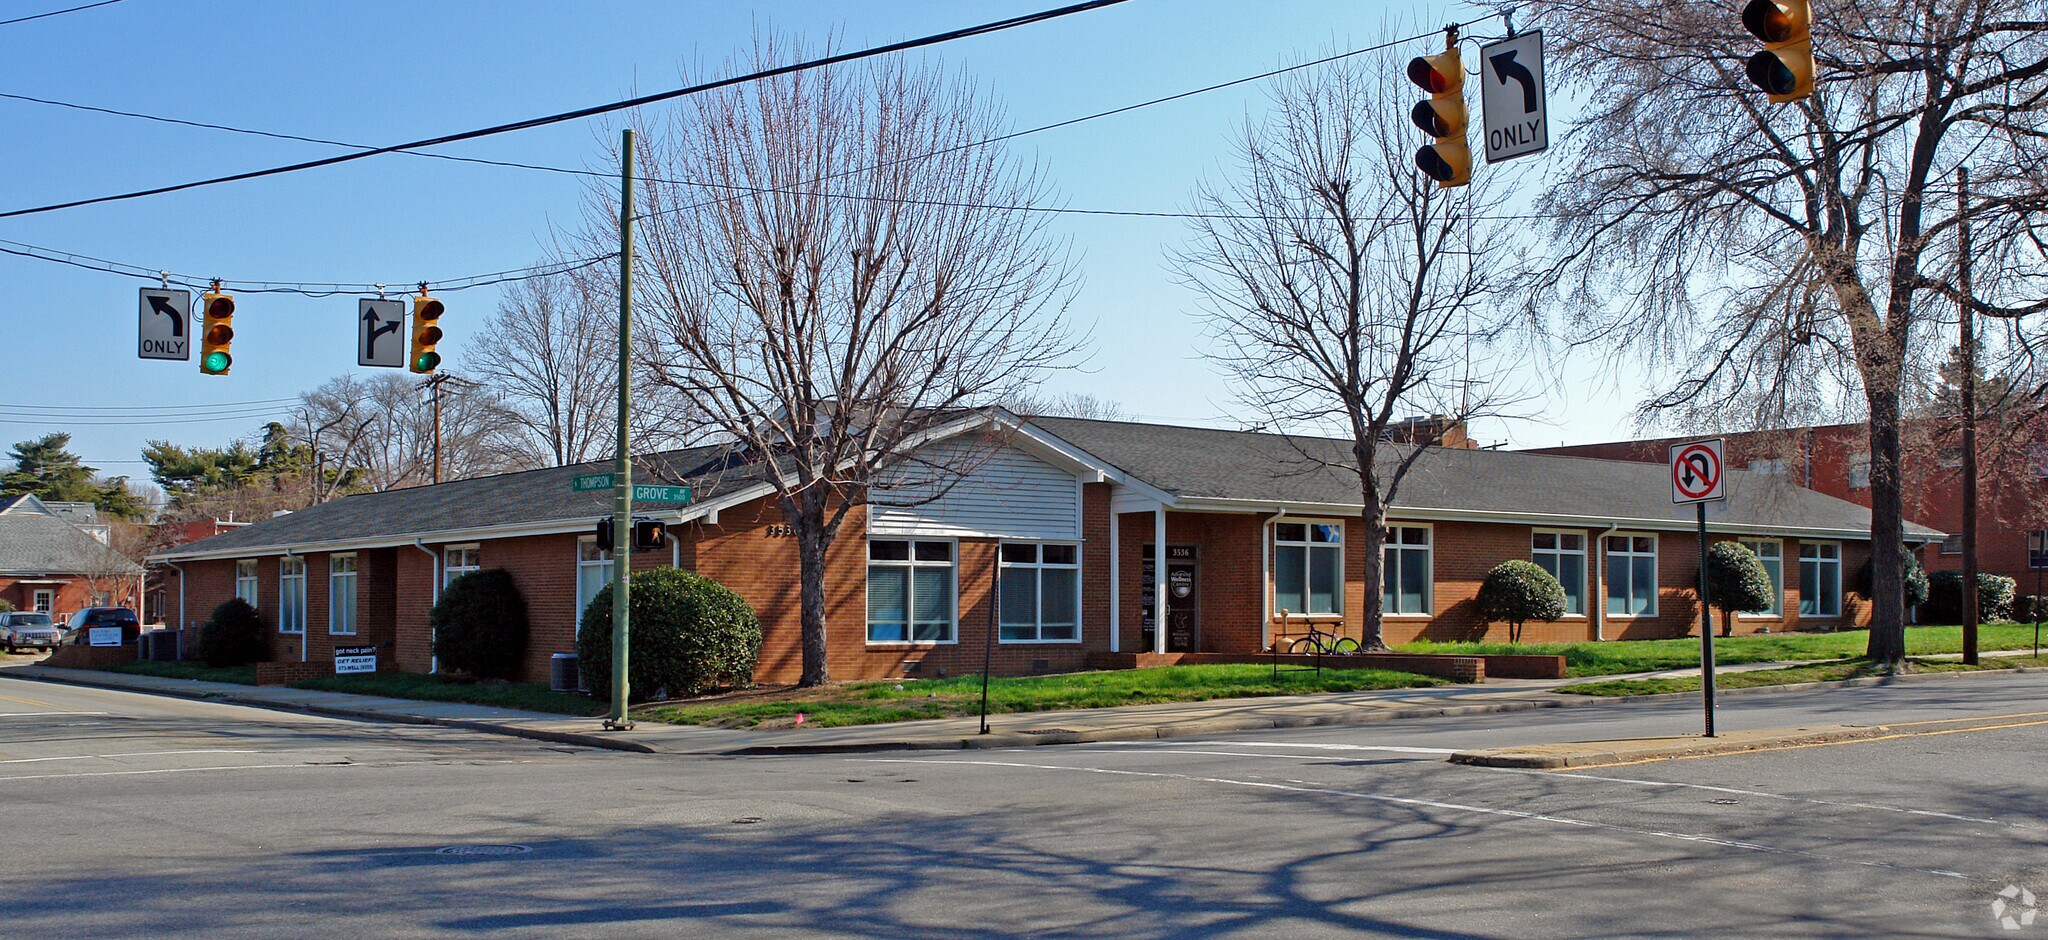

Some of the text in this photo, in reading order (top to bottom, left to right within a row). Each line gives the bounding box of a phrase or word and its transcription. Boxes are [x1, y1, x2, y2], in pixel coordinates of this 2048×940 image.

[1490, 119, 1540, 151] ONLY
[143, 339, 184, 354] ONLY
[580, 475, 610, 489] THOMPSON
[636, 486, 669, 500] GROVE
[335, 648, 345, 656] got
[360, 646, 376, 655] pain?
